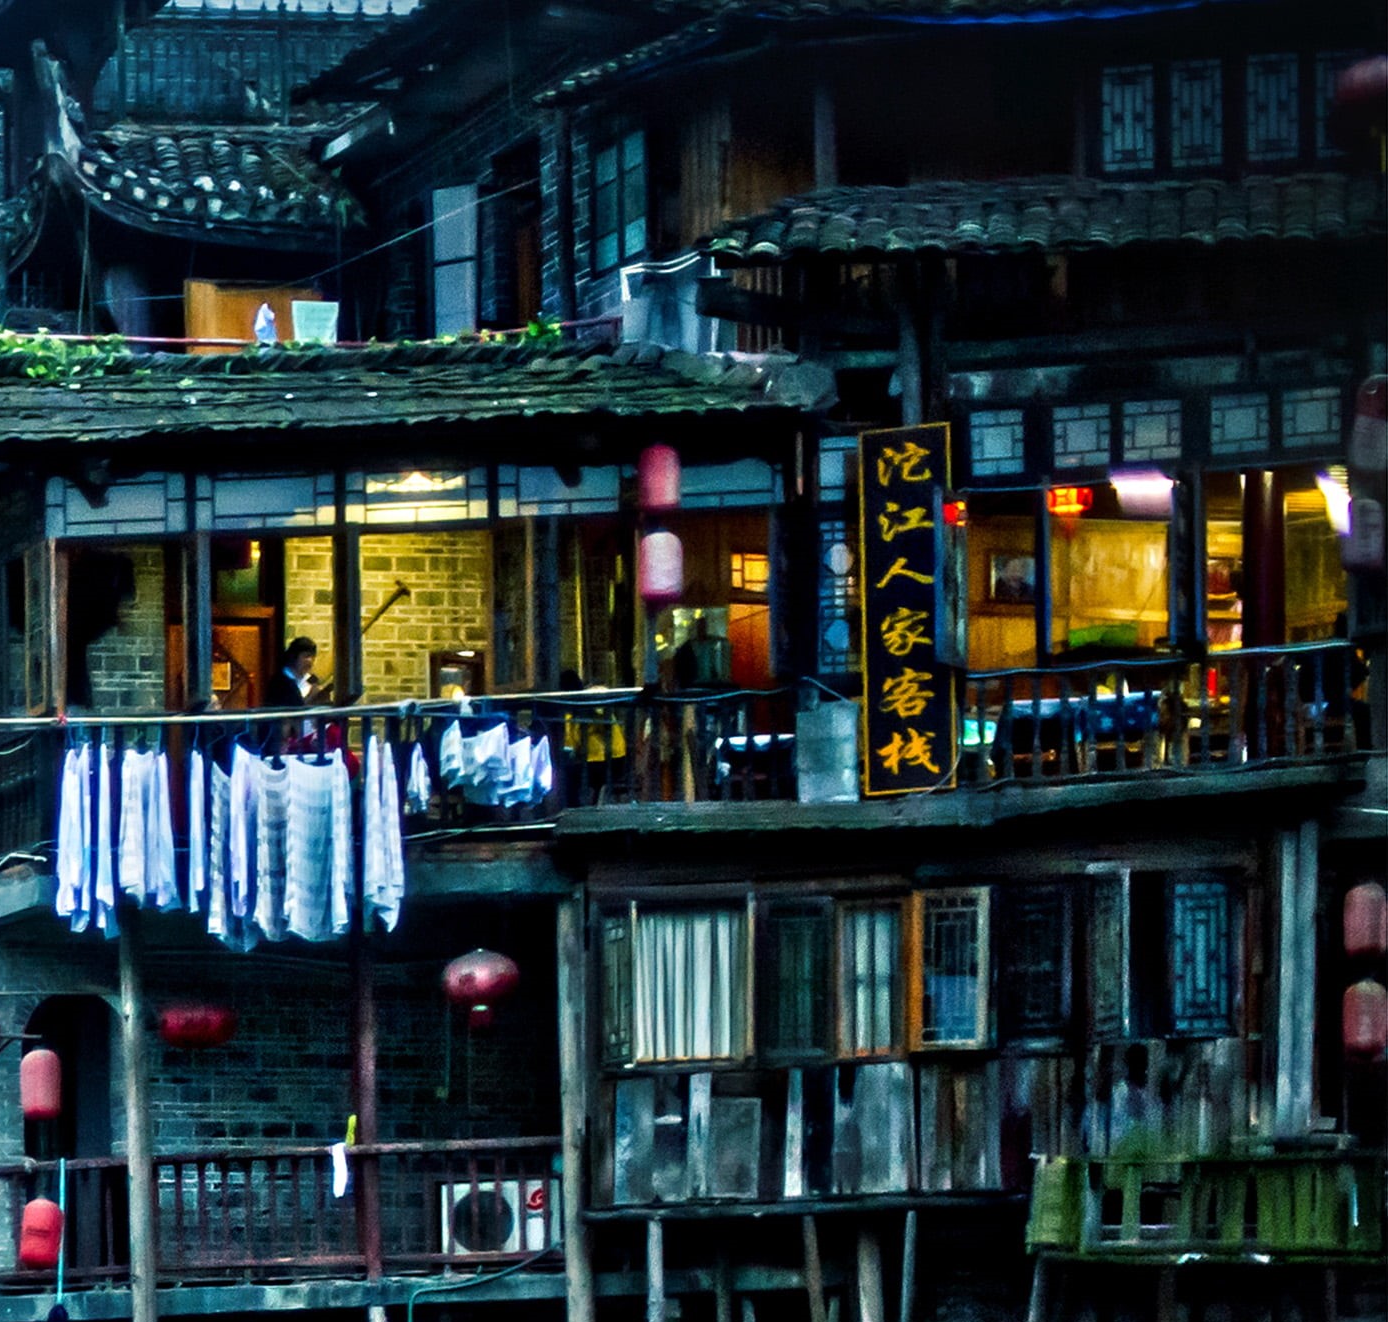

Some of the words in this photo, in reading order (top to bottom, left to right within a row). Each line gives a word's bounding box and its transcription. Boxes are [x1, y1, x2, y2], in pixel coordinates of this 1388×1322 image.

[876, 441, 941, 775] 沱江人家客栈
